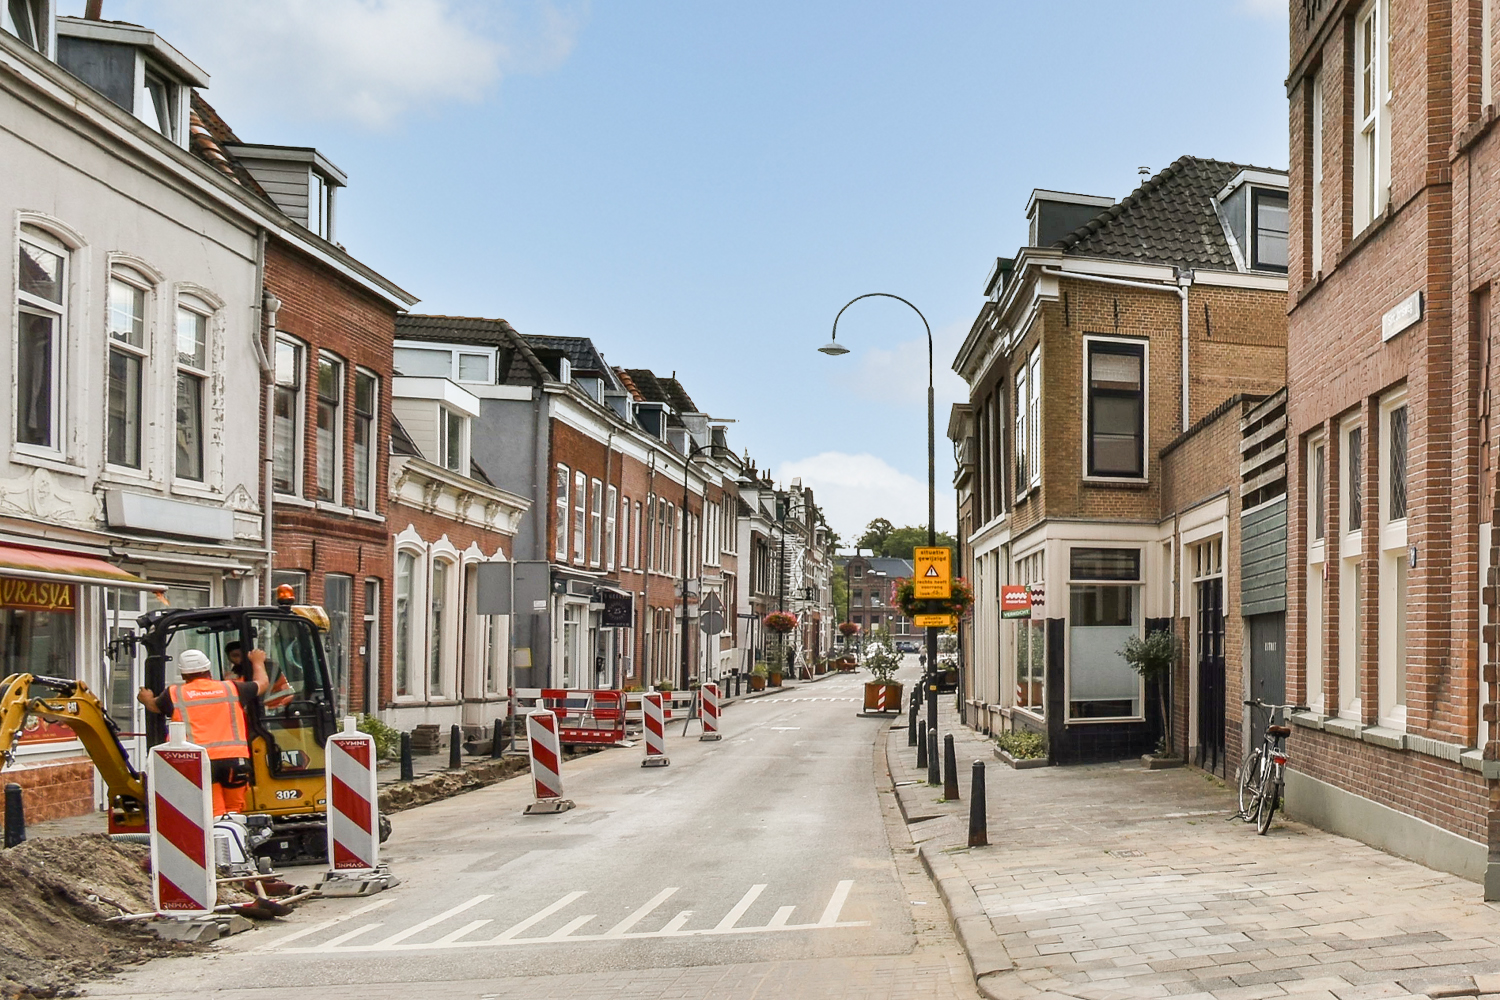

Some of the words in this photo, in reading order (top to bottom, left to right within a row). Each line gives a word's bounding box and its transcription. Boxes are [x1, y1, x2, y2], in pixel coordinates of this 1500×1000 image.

[0, 580, 70, 610] VRASYA
[172, 752, 199, 760] VMNL
[276, 789, 298, 800] 302
